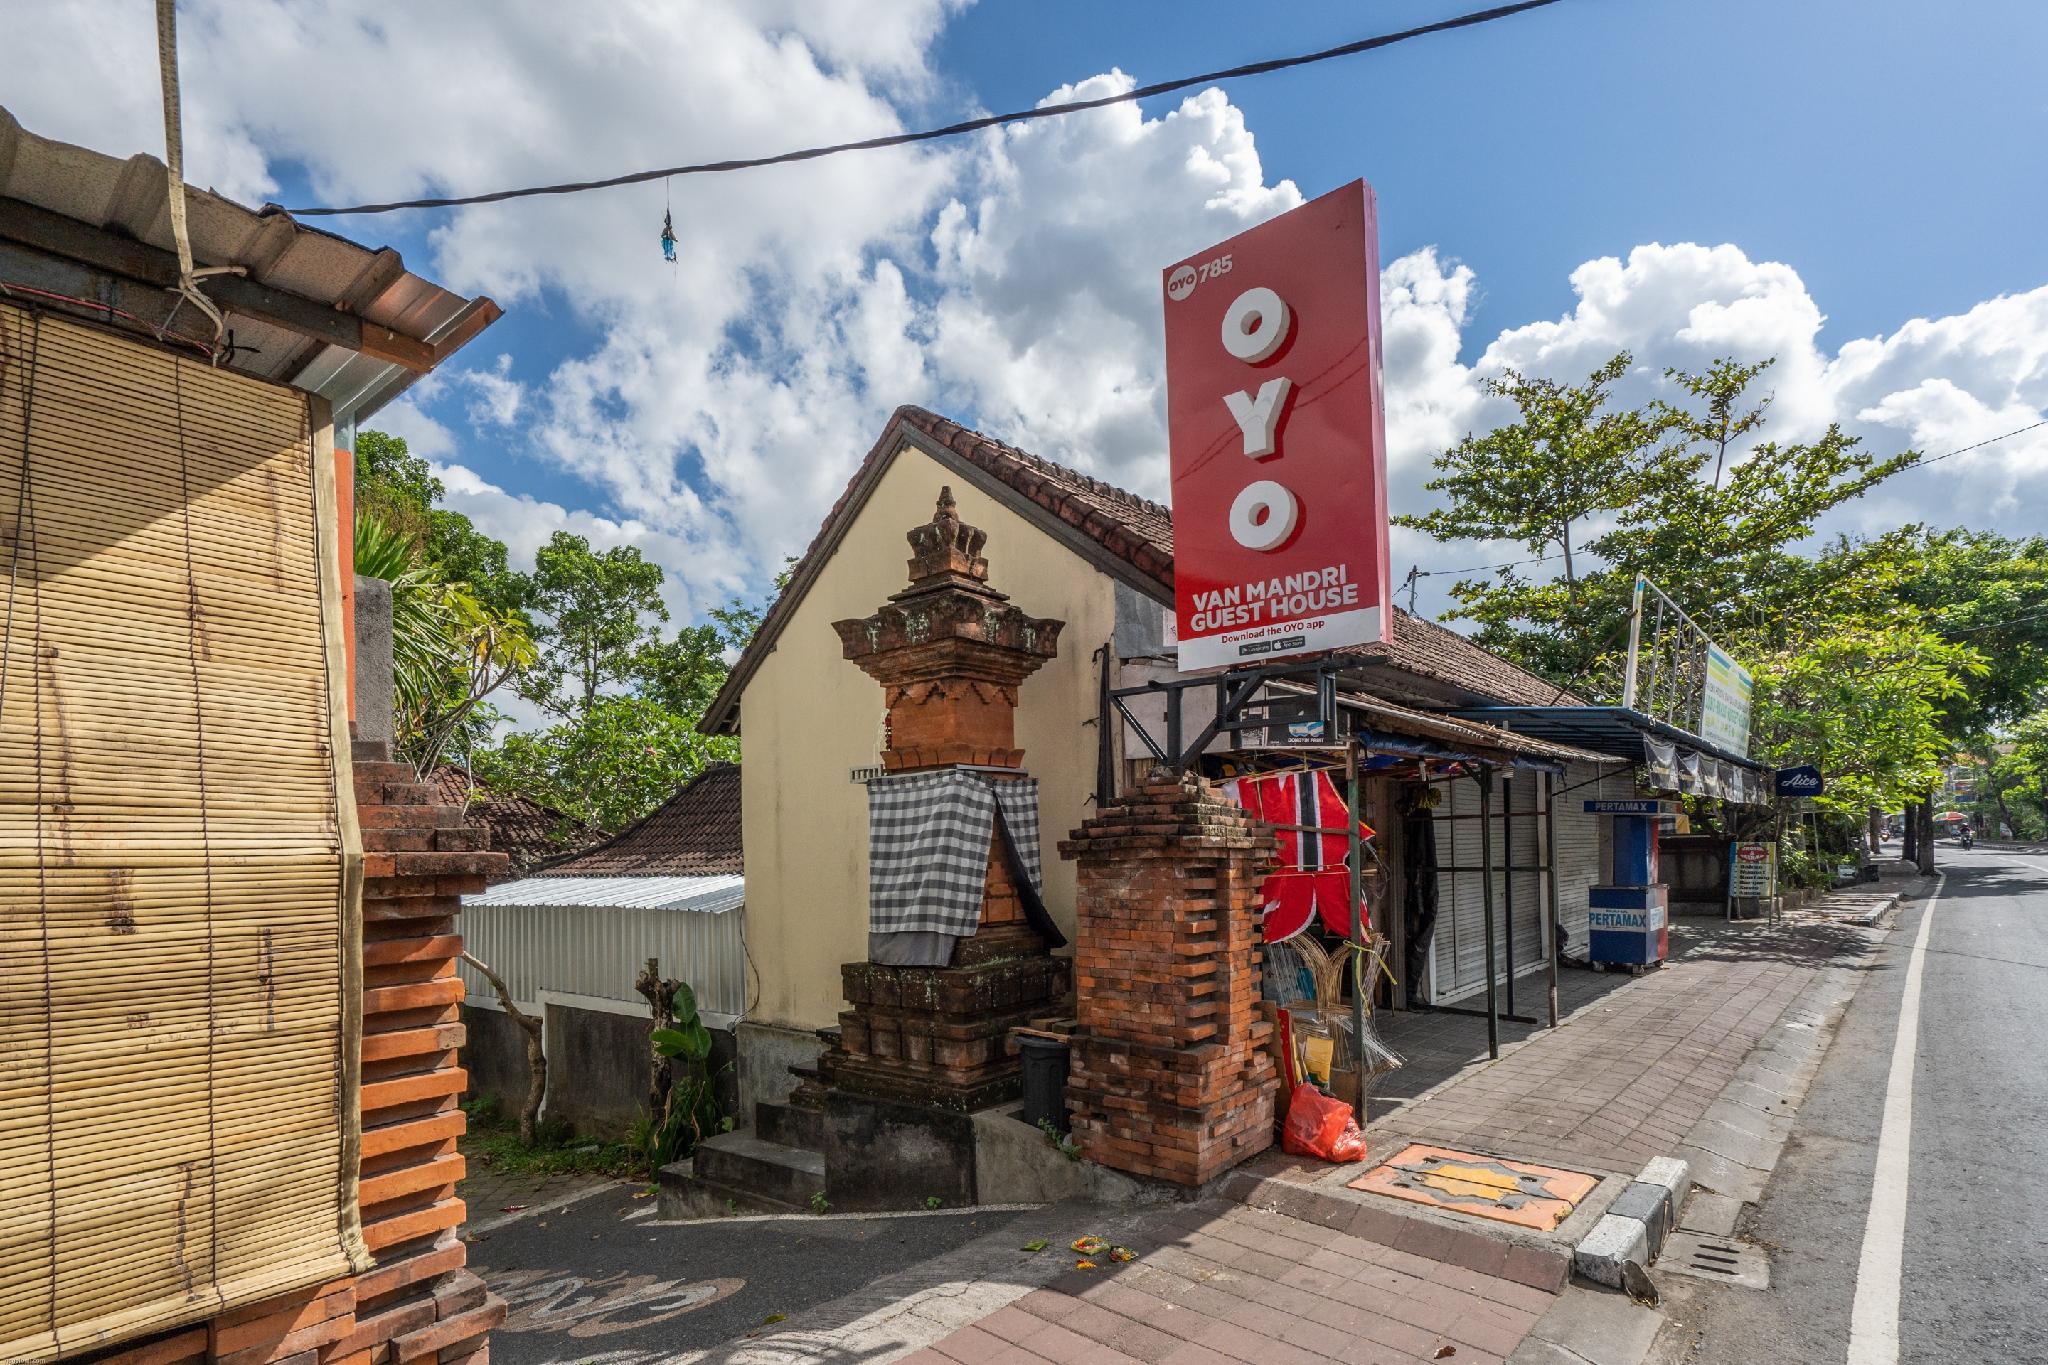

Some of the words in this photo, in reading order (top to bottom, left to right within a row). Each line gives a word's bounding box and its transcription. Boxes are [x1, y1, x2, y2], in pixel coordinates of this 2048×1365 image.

[1169, 273, 1195, 291] OYO
[1199, 254, 1232, 283] 785
[1221, 286, 1299, 552] OYO
[1192, 586, 1240, 612] VAN
[1246, 564, 1347, 602] MANDRI
[1190, 601, 1264, 632] GUEST
[1270, 583, 1359, 618] HOUSE
[1221, 628, 1265, 644] Download
[1267, 625, 1282, 636] the
[1283, 622, 1304, 633] OYO
[1306, 620, 1325, 630] app
[1781, 773, 1819, 787] Aice
[1595, 802, 1648, 811] PERTAMAX
[1589, 911, 1647, 928] PERTAMAX
